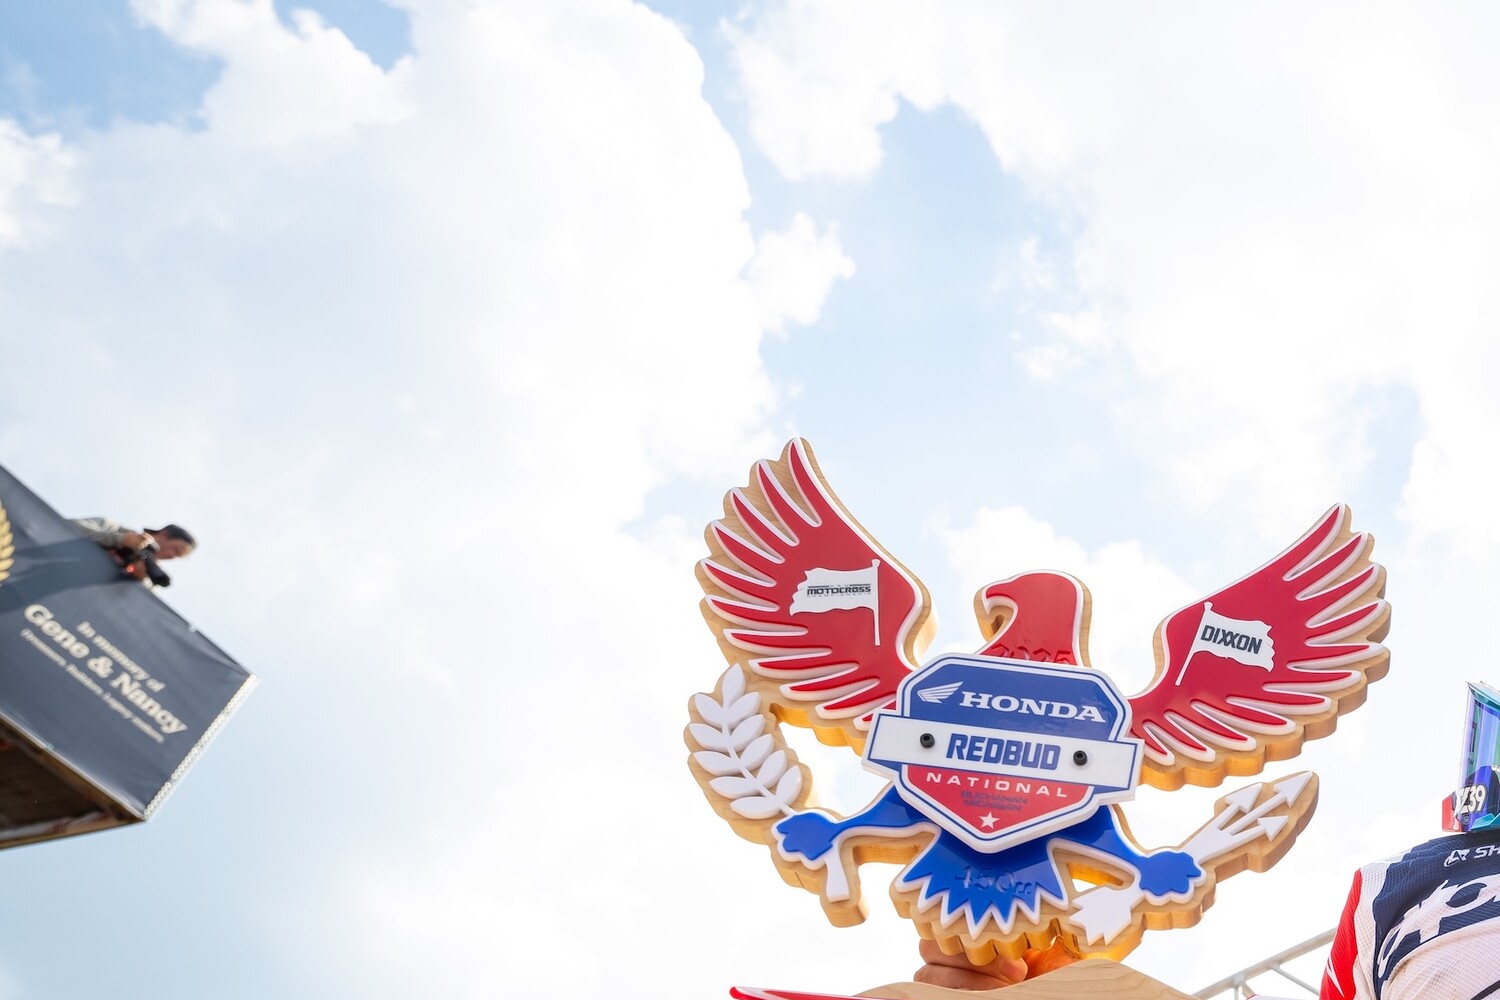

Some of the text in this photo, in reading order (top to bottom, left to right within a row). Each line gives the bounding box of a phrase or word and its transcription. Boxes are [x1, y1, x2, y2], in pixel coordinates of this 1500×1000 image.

[807, 586, 871, 596] MOTOCROSS
[1200, 624, 1262, 654] DIXXON
[24, 604, 188, 734] Gene & Nancy
[959, 690, 1106, 723] HONDA
[946, 732, 1062, 771] REDBUD
[926, 772, 1068, 798] NATIONAL
